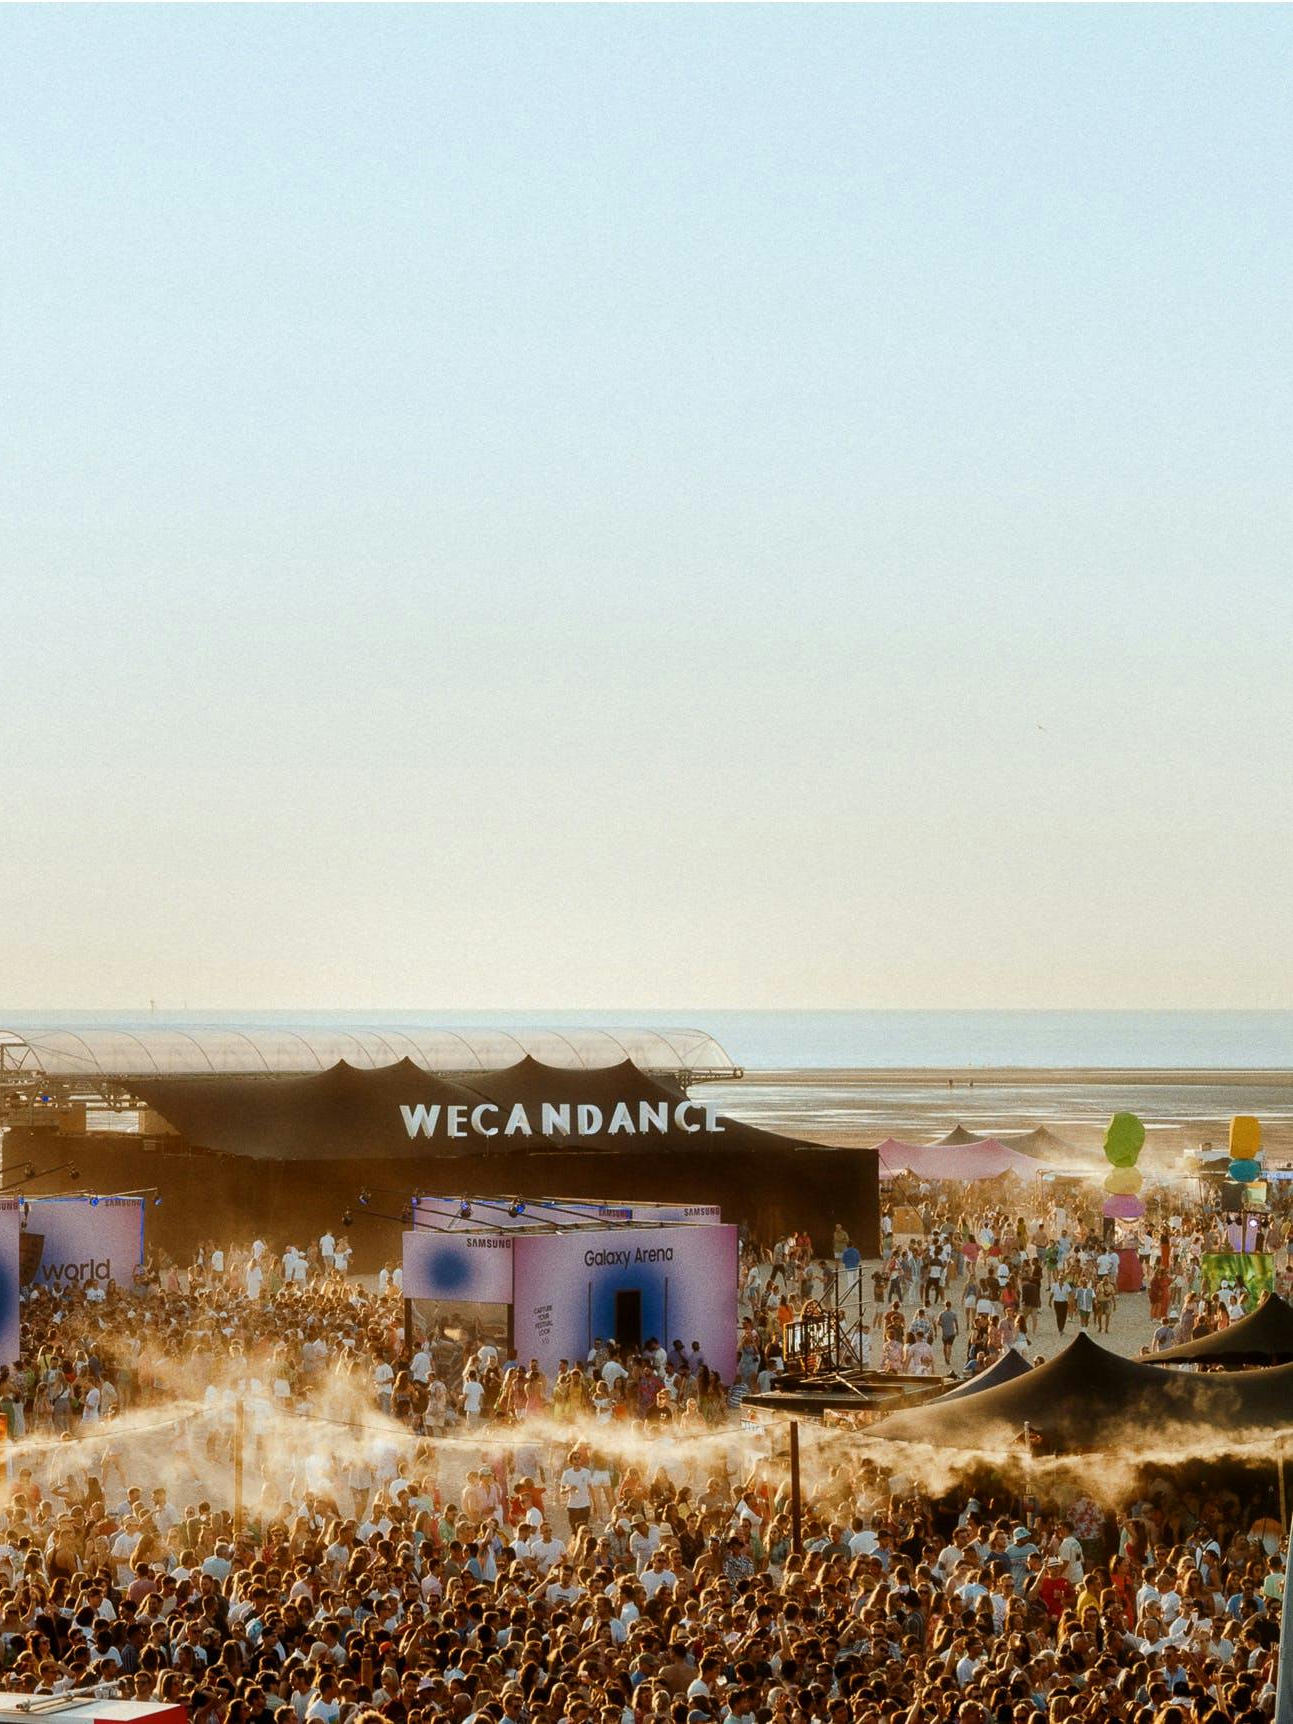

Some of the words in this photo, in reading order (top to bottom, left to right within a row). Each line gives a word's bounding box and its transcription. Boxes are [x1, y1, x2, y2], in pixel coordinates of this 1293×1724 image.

[399, 1099, 726, 1138] WECANDANCE
[105, 1199, 142, 1207] SAMSUNG
[683, 1207, 720, 1217] SAMSUNG
[466, 1238, 511, 1249] SAMSUNG
[584, 1249, 631, 1269] Galaxy
[634, 1247, 674, 1262] Arena
[42, 1258, 111, 1281] world
